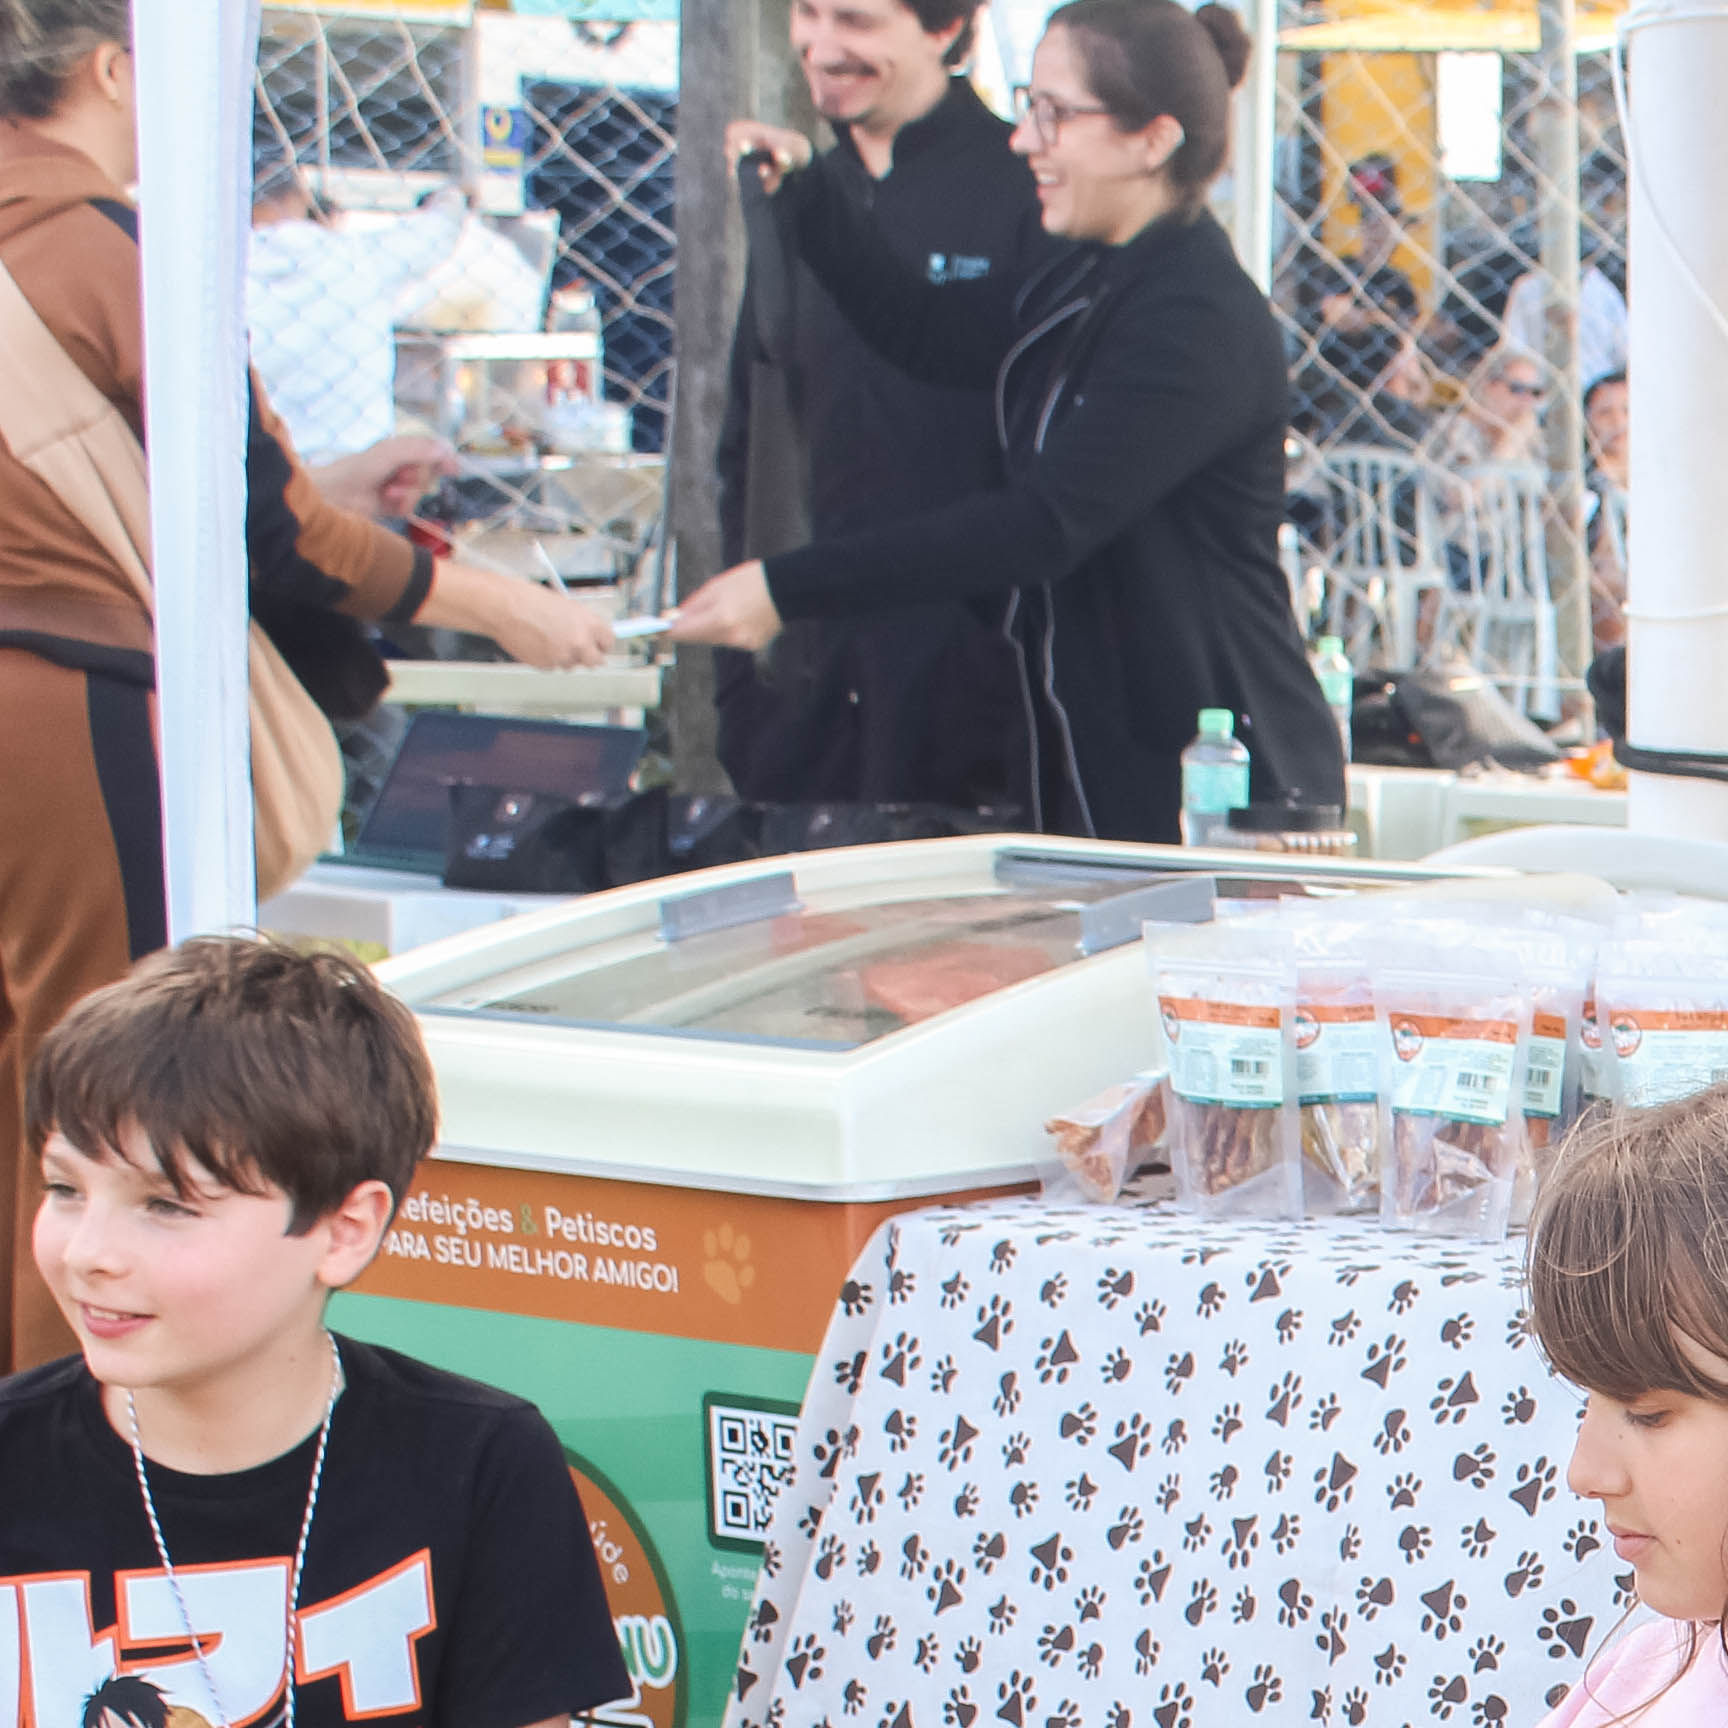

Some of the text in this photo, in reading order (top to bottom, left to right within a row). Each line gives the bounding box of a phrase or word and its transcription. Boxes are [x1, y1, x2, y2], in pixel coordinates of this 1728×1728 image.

[400, 1191, 514, 1235] efeições
[544, 1205, 657, 1251] Petiscos
[383, 1230, 680, 1293] ARA SEU MELHOR AMIGO!
